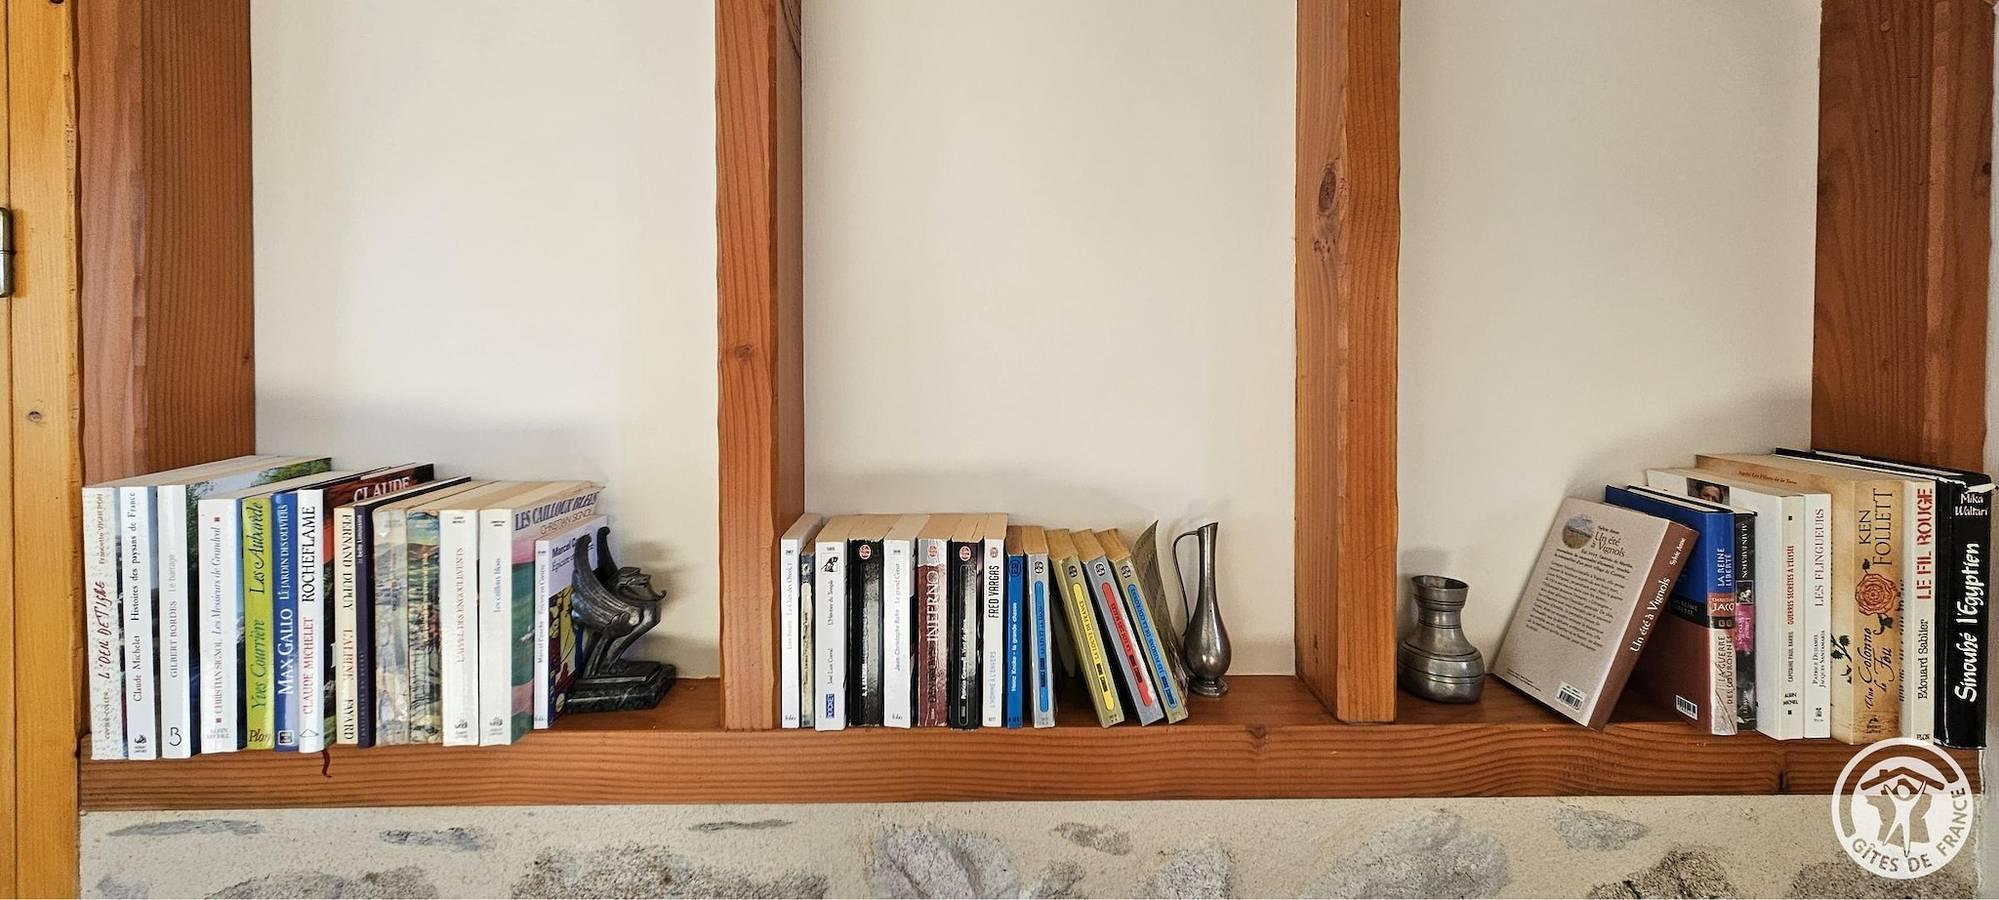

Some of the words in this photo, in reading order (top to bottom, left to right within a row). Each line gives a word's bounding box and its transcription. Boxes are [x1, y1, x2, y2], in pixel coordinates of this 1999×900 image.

[353, 476, 410, 502] CLAUDE
[1960, 493, 1984, 504] Mika
[127, 492, 138, 518] France
[1916, 488, 1933, 546] ROUGE
[1954, 505, 1988, 516] Waltari
[128, 520, 138, 531] de
[247, 502, 264, 569] Aubarède
[514, 510, 531, 531] LES
[1859, 510, 1872, 545] KEN
[1872, 488, 1893, 566] FOLLETT
[129, 535, 141, 564] paysans
[301, 506, 316, 602] ROCHEFLAME
[342, 514, 352, 567] FERNAND
[1594, 531, 1607, 546] Un
[1608, 536, 1621, 547] été
[1599, 541, 1625, 557] Vignols
[1814, 508, 1824, 580] FLINGUEURS
[211, 568, 221, 578] de
[278, 558, 290, 589] JARDIN
[1669, 551, 1681, 566] Sylvie
[1716, 548, 1725, 574] REINE
[1916, 551, 1932, 577] FIL
[129, 568, 139, 581] des
[250, 572, 265, 594] Les
[988, 565, 1000, 597] VARGAS
[1717, 575, 1725, 587] LA
[1786, 573, 1794, 599] SECRÈTES
[1916, 578, 1932, 600] LE
[1956, 543, 1985, 625] l'Egyptien
[130, 585, 140, 621] Histoires
[211, 580, 222, 619] Messieurs
[343, 573, 352, 609] DUPUY
[926, 570, 939, 641] INFERNO
[1647, 577, 1671, 611] Vignols
[1814, 585, 1824, 607] LES
[169, 601, 178, 637] BORDES
[988, 599, 999, 618] FRED
[1645, 613, 1655, 621] à
[1786, 600, 1794, 625] GUERRES
[211, 621, 222, 636] Les
[277, 609, 294, 656] GALLO
[1640, 619, 1652, 635] été
[1917, 618, 1928, 658] Sablier
[132, 635, 142, 670] Michelet
[249, 619, 266, 678] Courrière
[302, 617, 314, 670] MICHELET
[1630, 636, 1644, 653] Un
[1717, 636, 1726, 670] GUERRE
[169, 639, 178, 679] GILBERT
[1954, 630, 1978, 703] Sinouhé
[132, 674, 142, 702] Claude
[278, 658, 294, 694] MAX
[1917, 660, 1928, 700] Edouard
[212, 670, 223, 715] CHRISTIAN
[251, 683, 266, 710] Yves
[302, 673, 314, 715] CLAUDE
[1726, 690, 1734, 705] DES
